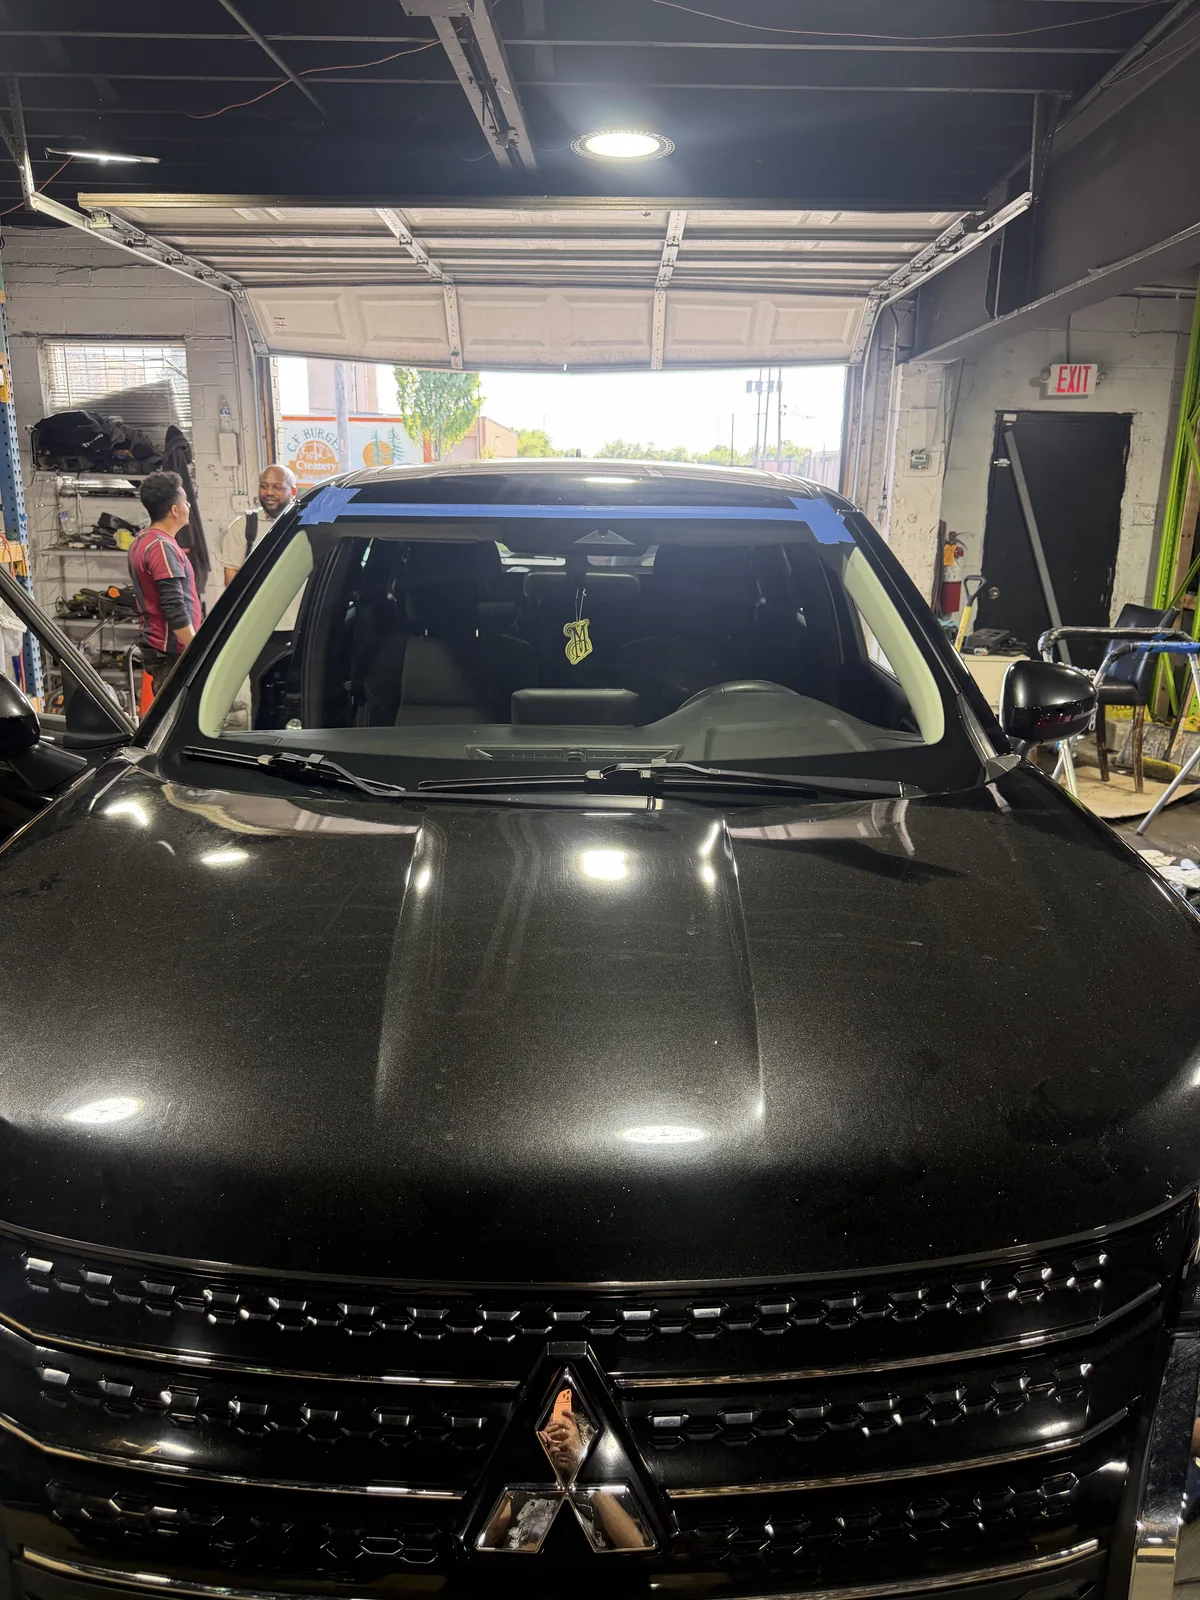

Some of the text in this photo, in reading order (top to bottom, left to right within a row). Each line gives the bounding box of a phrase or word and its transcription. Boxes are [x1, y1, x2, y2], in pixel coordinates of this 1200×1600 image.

[1056, 365, 1092, 393] EXIT
[303, 427, 339, 451] BURGE
[295, 460, 337, 473] Creamery
